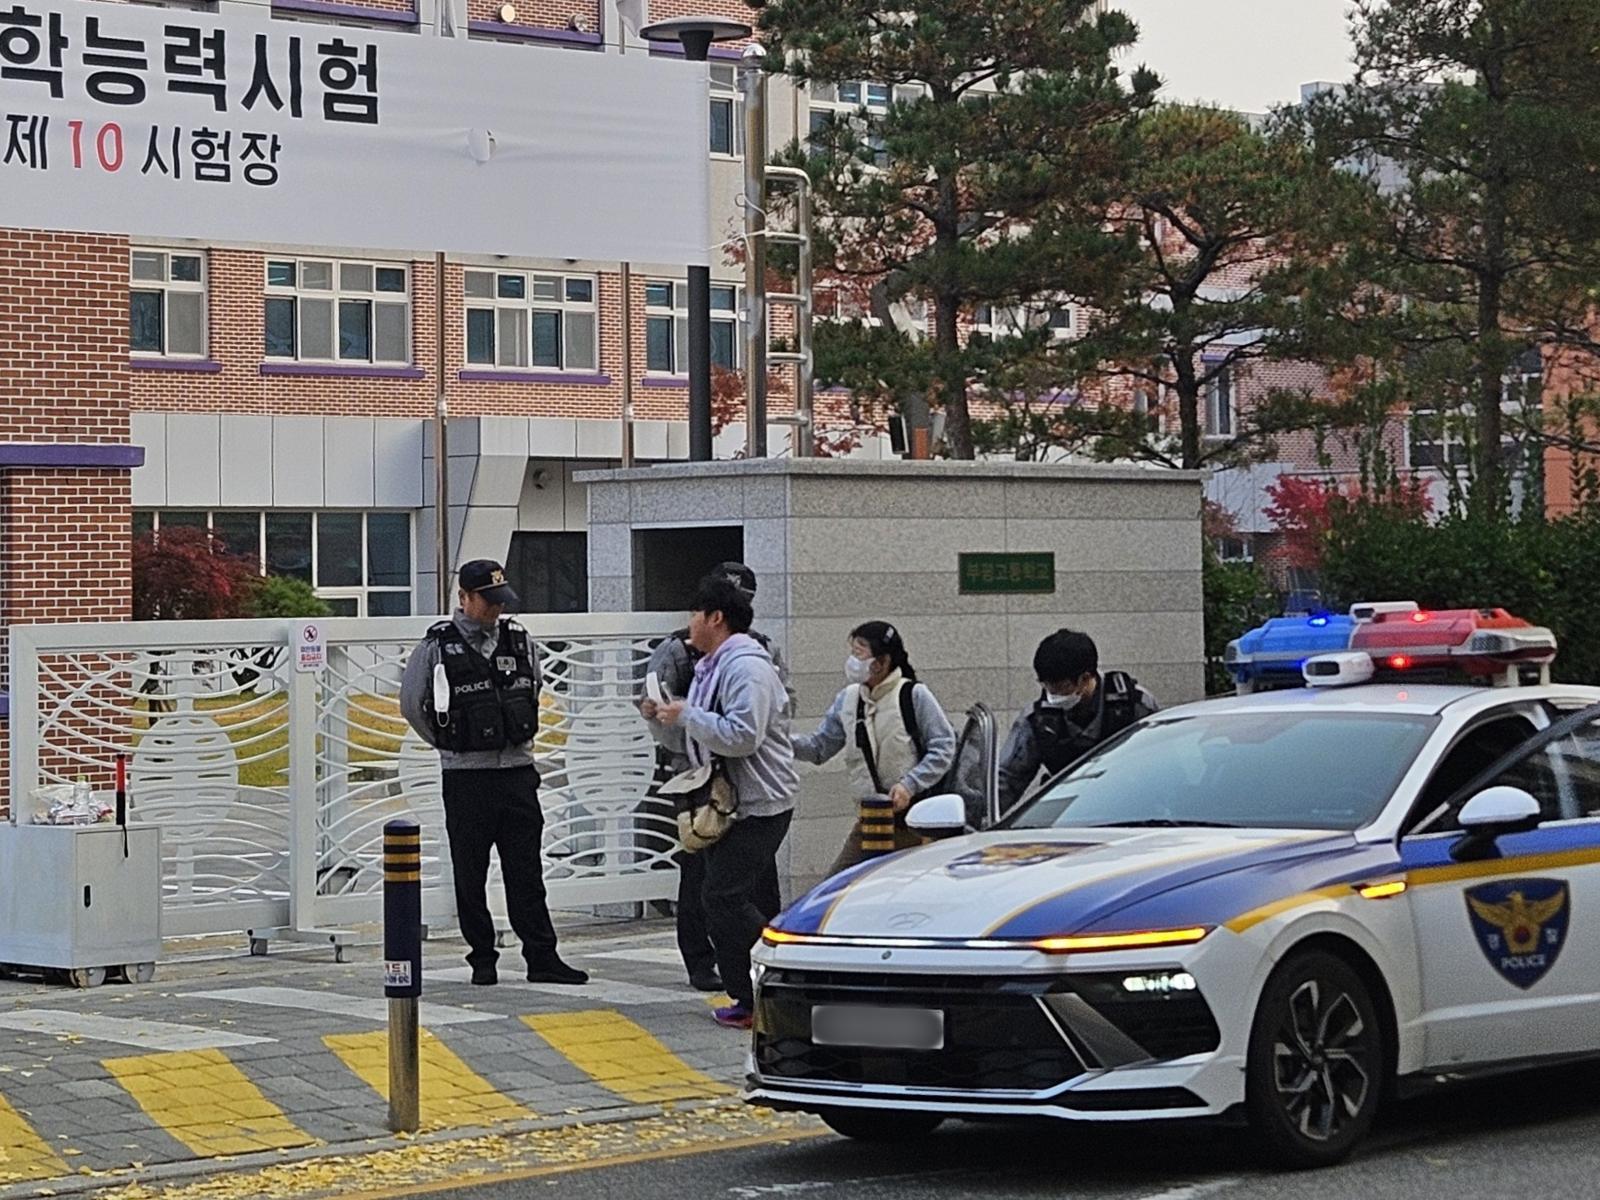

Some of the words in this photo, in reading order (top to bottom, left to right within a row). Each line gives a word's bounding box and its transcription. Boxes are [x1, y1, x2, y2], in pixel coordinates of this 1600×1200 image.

[0, 5, 378, 124] 학능력시험
[3, 114, 49, 169] 제
[68, 120, 123, 172] 10
[141, 125, 281, 186] 시험장
[454, 680, 490, 695] POLICE
[1501, 954, 1546, 969] POLICE
